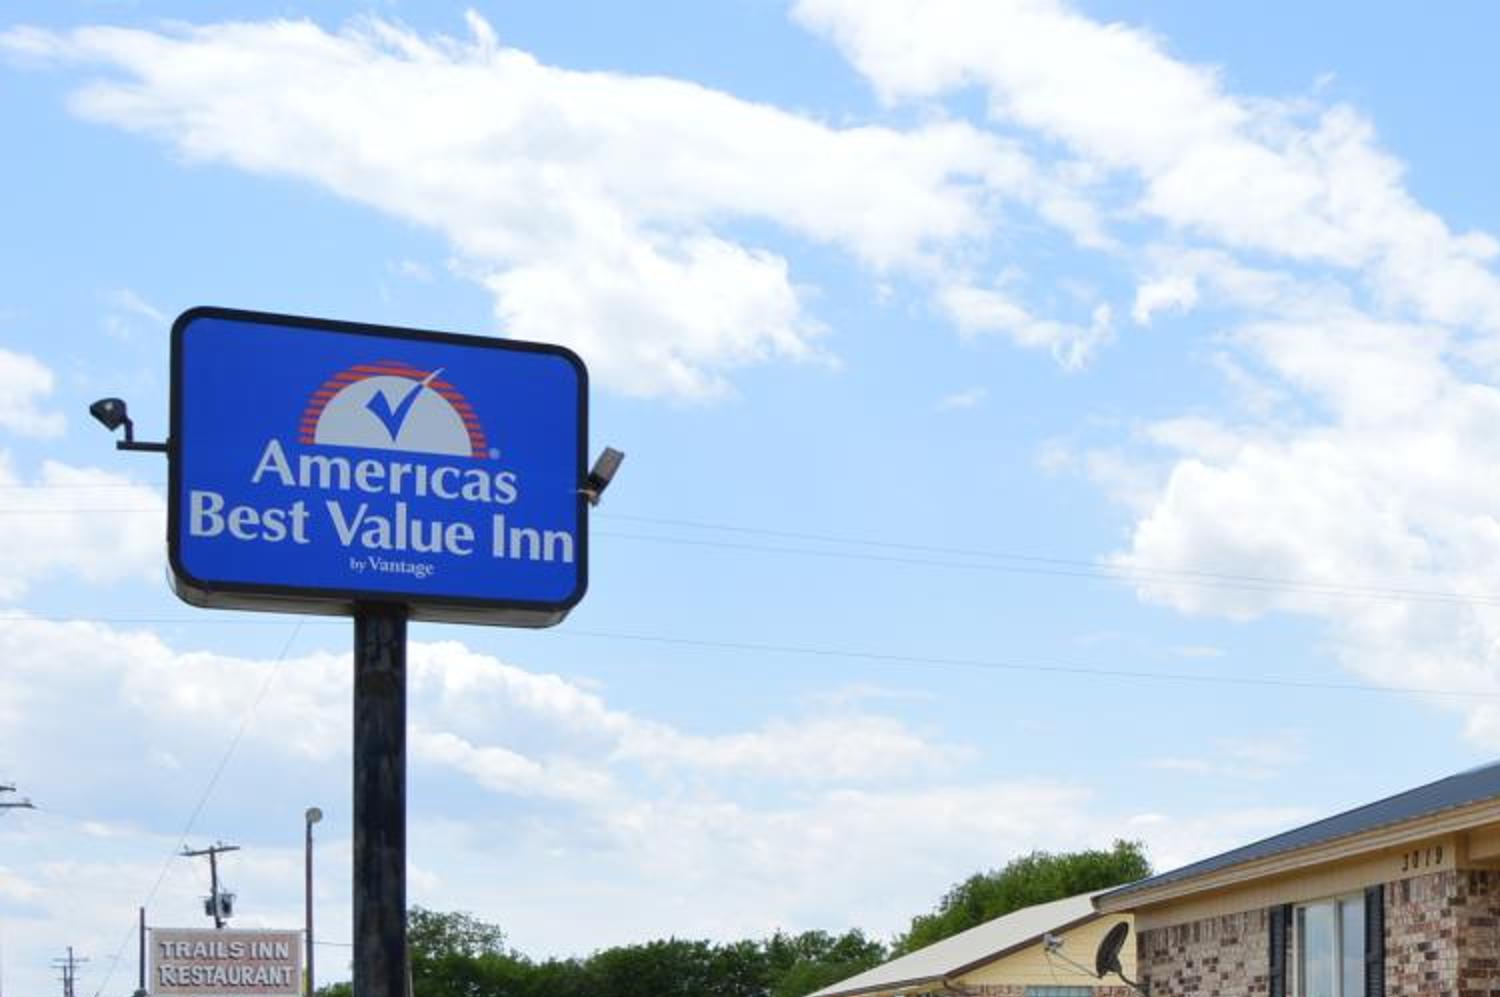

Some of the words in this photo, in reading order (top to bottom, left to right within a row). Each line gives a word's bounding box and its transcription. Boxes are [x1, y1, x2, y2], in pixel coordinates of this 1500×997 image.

[251, 438, 519, 505] Americas
[189, 490, 311, 545] Best
[325, 499, 475, 555] Value
[492, 513, 575, 564] Inn
[349, 557, 366, 573] by
[368, 555, 434, 579] Vantage
[160, 941, 245, 960] TRAILS
[251, 941, 289, 960] INN
[159, 964, 294, 986] RESTAURANT
